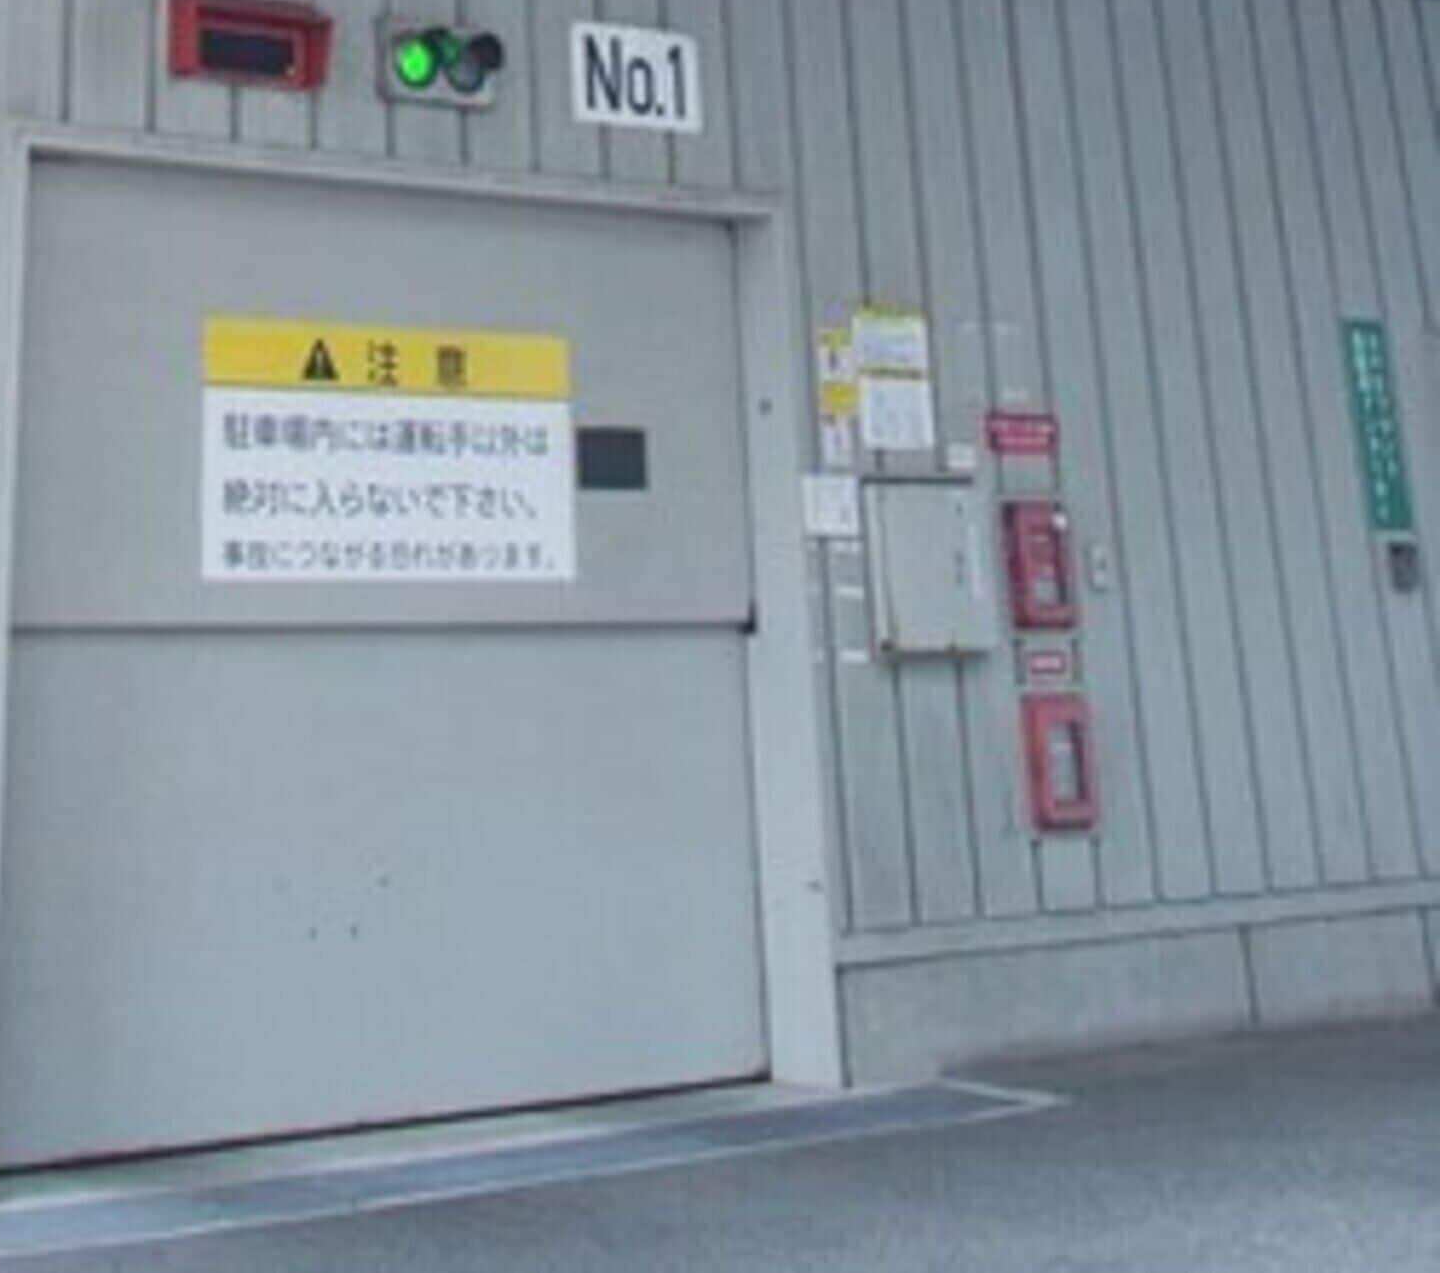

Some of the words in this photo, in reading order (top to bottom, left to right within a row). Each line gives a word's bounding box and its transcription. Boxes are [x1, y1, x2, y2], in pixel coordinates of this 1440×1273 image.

[583, 34, 688, 120] No.1
[223, 412, 549, 458] 駐車場内には運転手以外は
